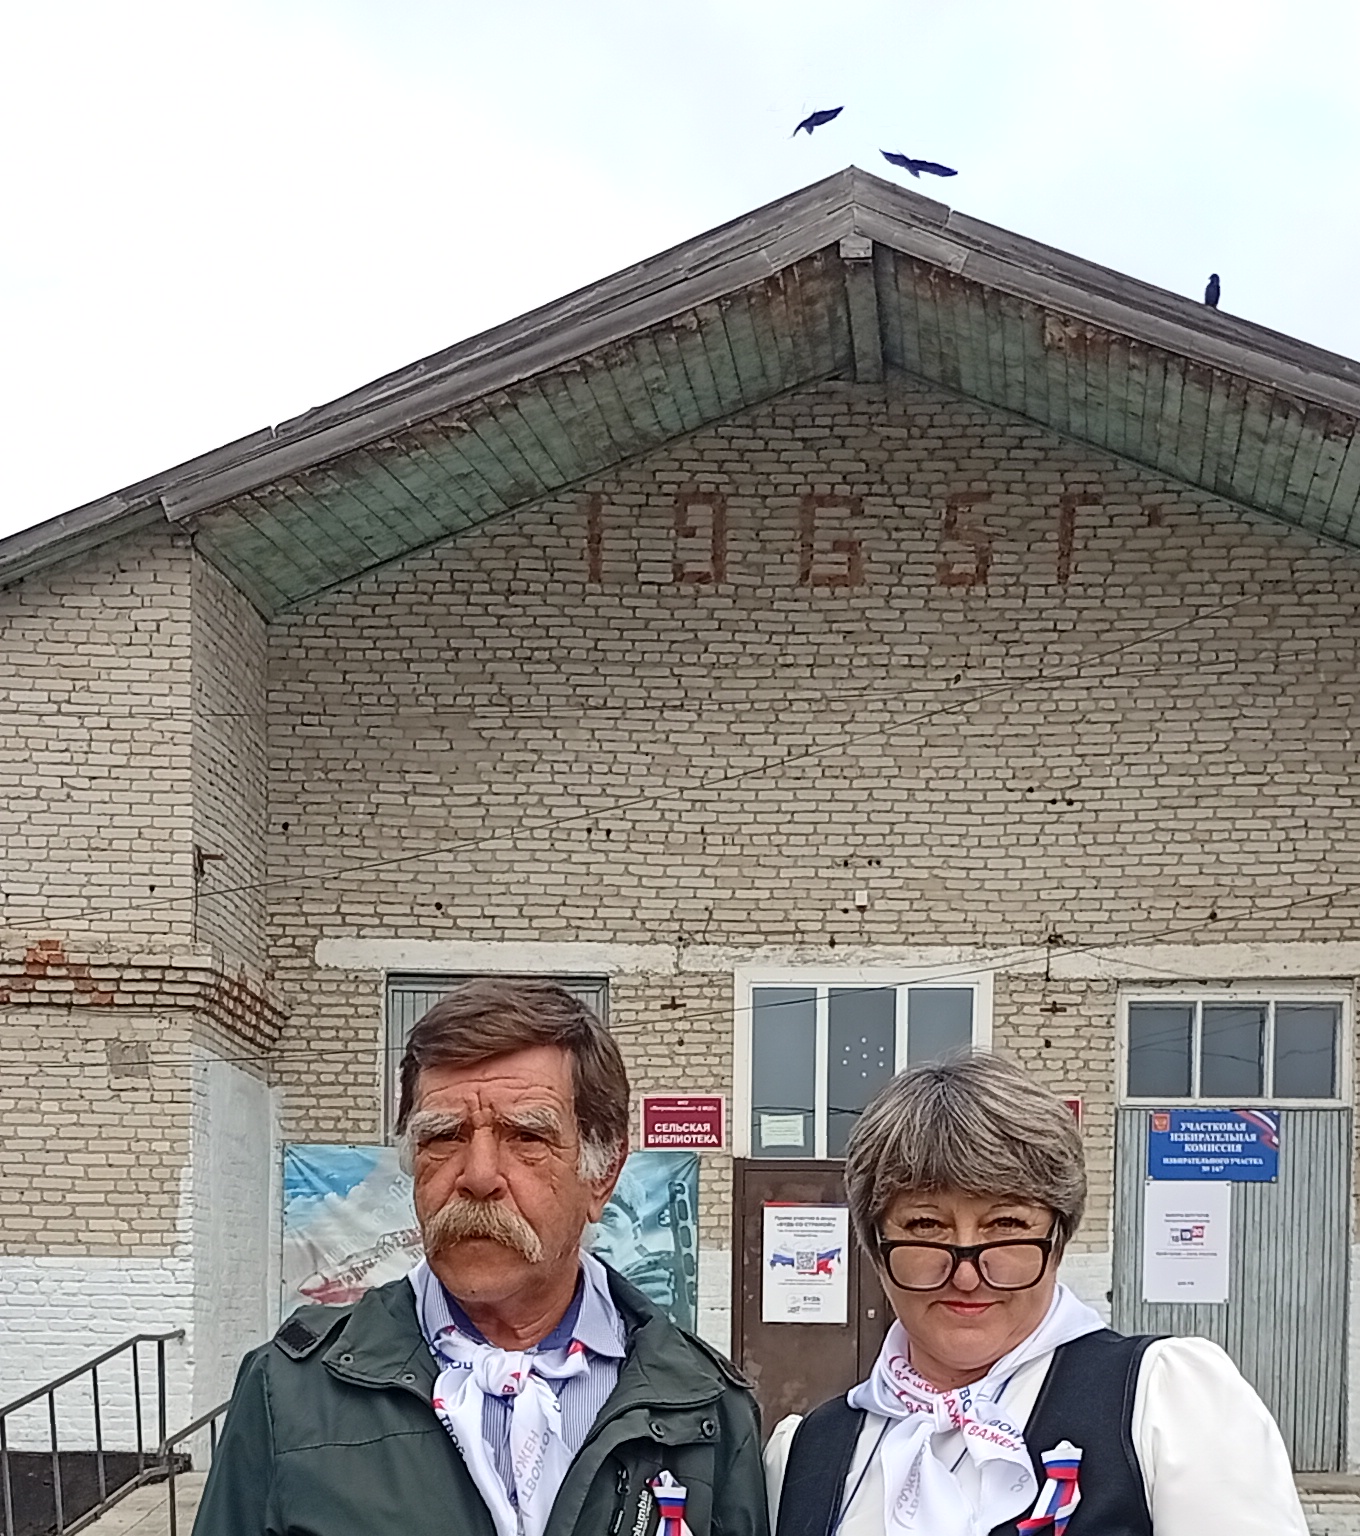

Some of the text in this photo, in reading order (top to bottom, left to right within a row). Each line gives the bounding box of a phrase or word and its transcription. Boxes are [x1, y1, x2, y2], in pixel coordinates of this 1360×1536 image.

[654, 1122, 711, 1132] СЕЛЬСКАЯ
[1180, 1122, 1247, 1132] УЧАСТКОВАЯ
[647, 1134, 718, 1144] БИБЛИОТЕКА
[1170, 1133, 1257, 1142] ИЗБИРАТЕЛЬНАЯ
[1184, 1143, 1242, 1152] КОМИССИЯ
[1230, 1157, 1264, 1165] УЧАСТКА
[968, 1425, 1021, 1452] ВАЖЕН
